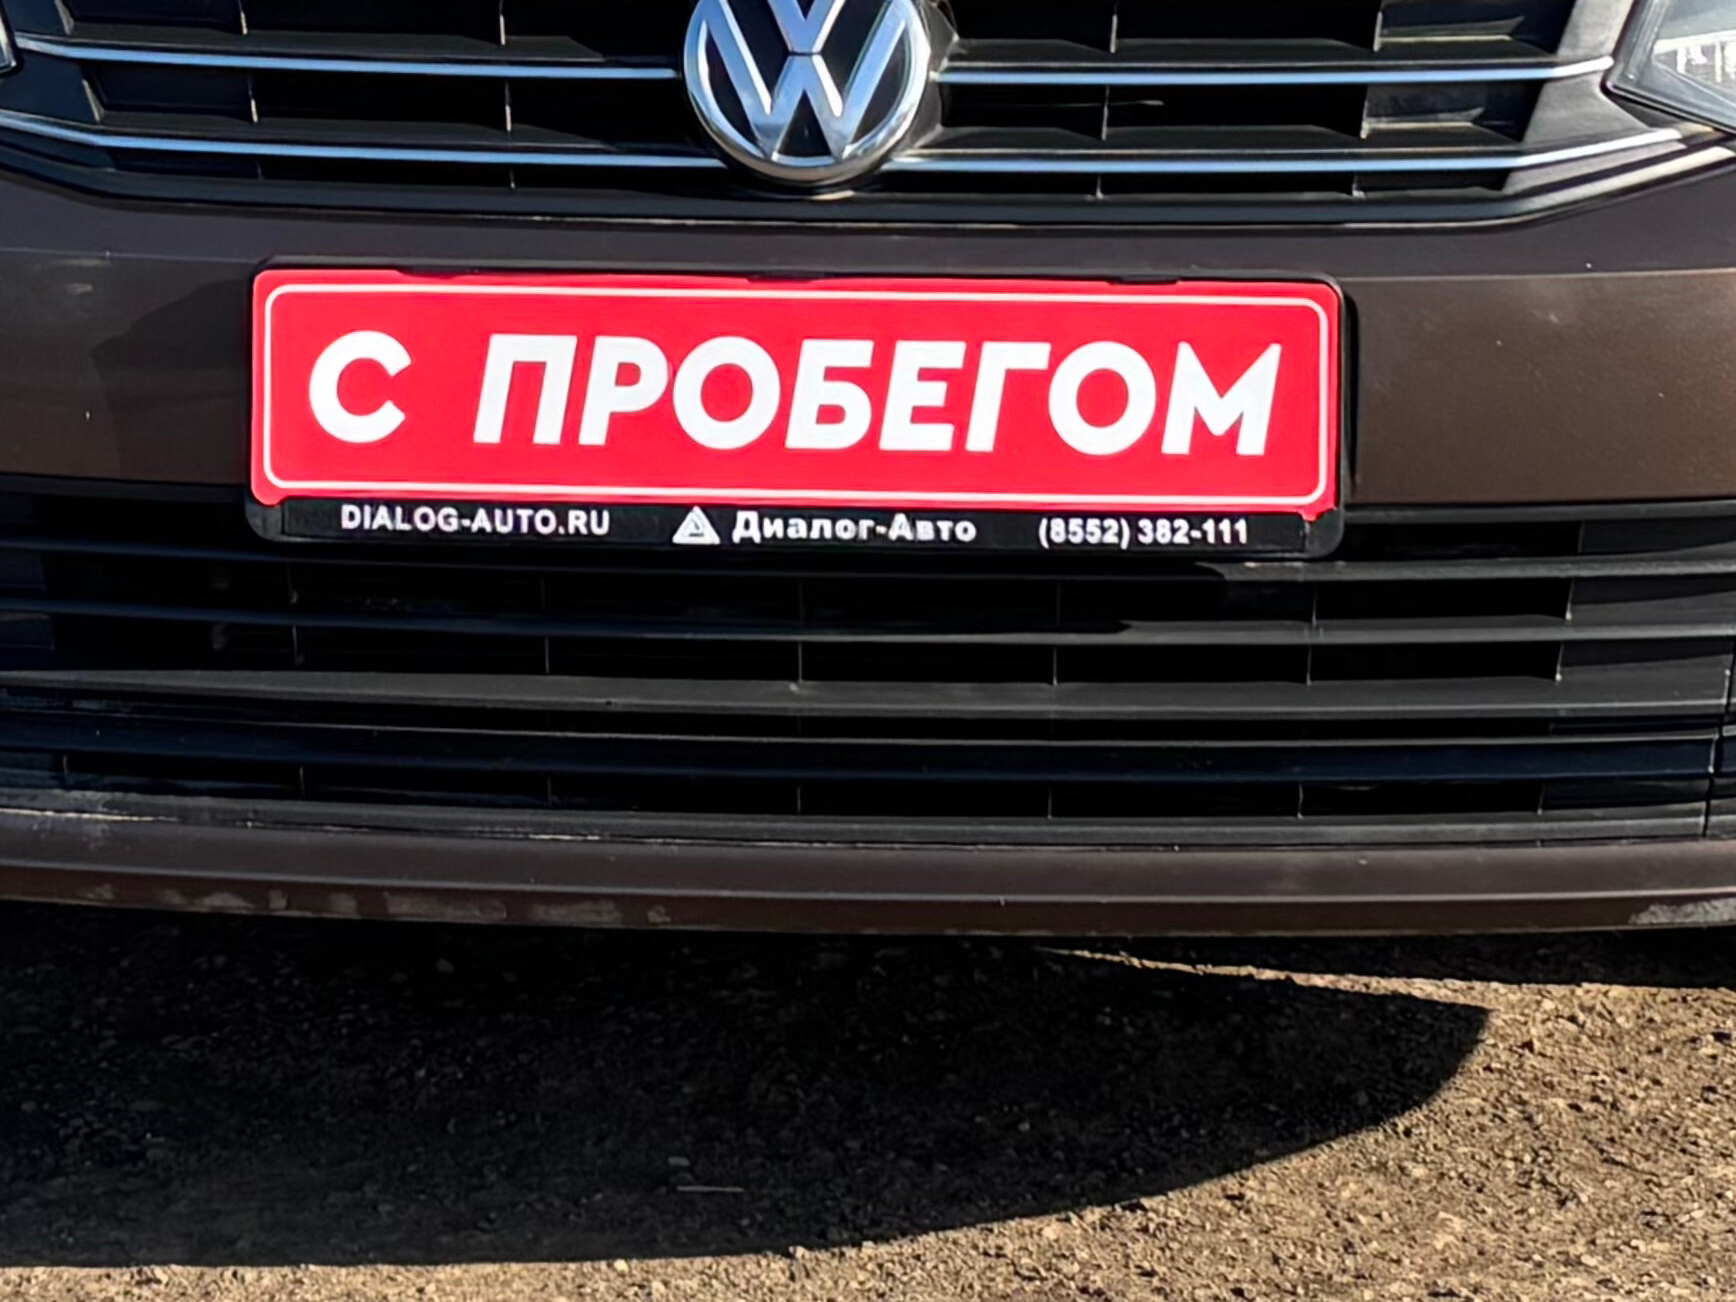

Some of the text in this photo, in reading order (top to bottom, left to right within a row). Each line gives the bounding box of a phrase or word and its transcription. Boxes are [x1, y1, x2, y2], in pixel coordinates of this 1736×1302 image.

[309, 330, 1282, 456] С ПРОБЕГОМ
[340, 504, 611, 536] DIALOG-AUTO.RU
[731, 509, 977, 545] Диалог-Авто
[1038, 517, 1248, 550] (8552) 382-111
